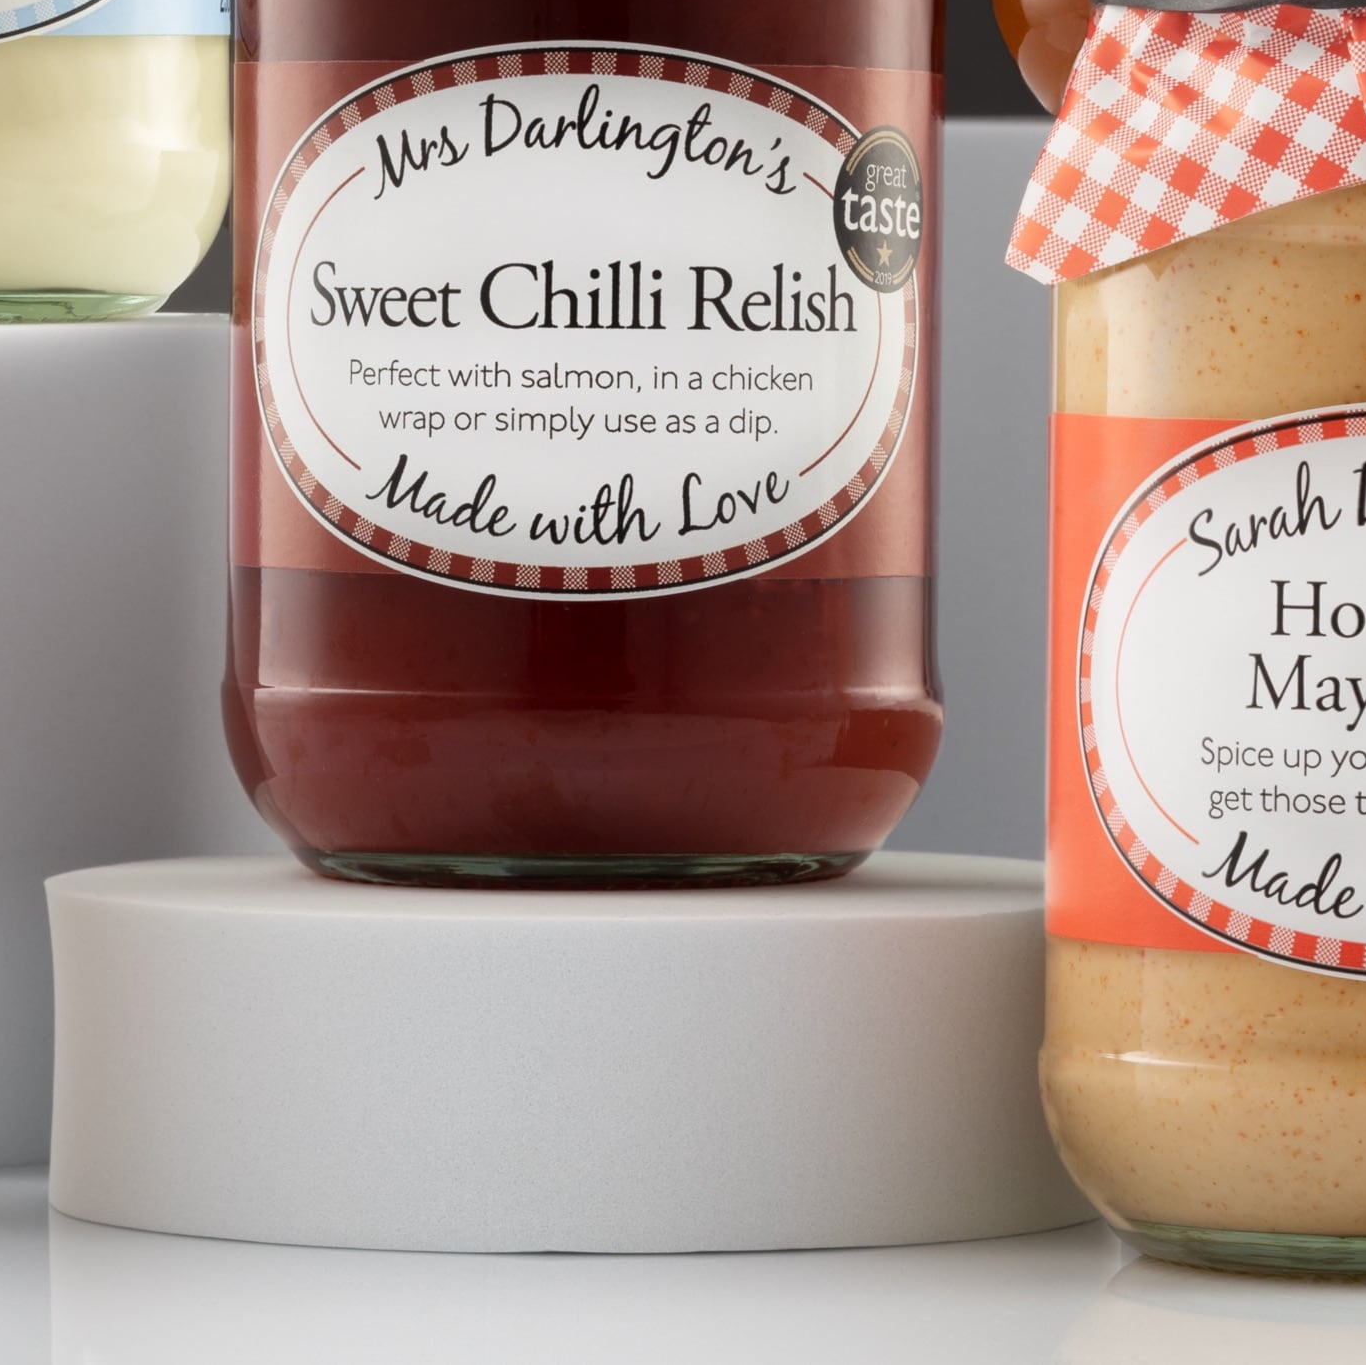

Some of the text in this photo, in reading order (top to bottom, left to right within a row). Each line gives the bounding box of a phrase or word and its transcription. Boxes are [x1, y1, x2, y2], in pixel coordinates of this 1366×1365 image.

[373, 83, 797, 201] Mrs Darlington's
[864, 163, 907, 192] great
[841, 187, 921, 240] taste
[311, 259, 858, 333] Sweet Chilli Relish
[874, 270, 893, 285] 2019
[349, 358, 813, 394] Perfect with salmon, in a chicken
[378, 405, 778, 442] wrap or simply use as a dip.
[365, 453, 790, 546] Made with Love
[1188, 460, 1343, 577] Sarah
[1201, 736, 1274, 774] Spice
[1283, 748, 1322, 777] up
[1208, 787, 1253, 820] get
[1259, 784, 1346, 815] those
[1201, 830, 1365, 919] Made
